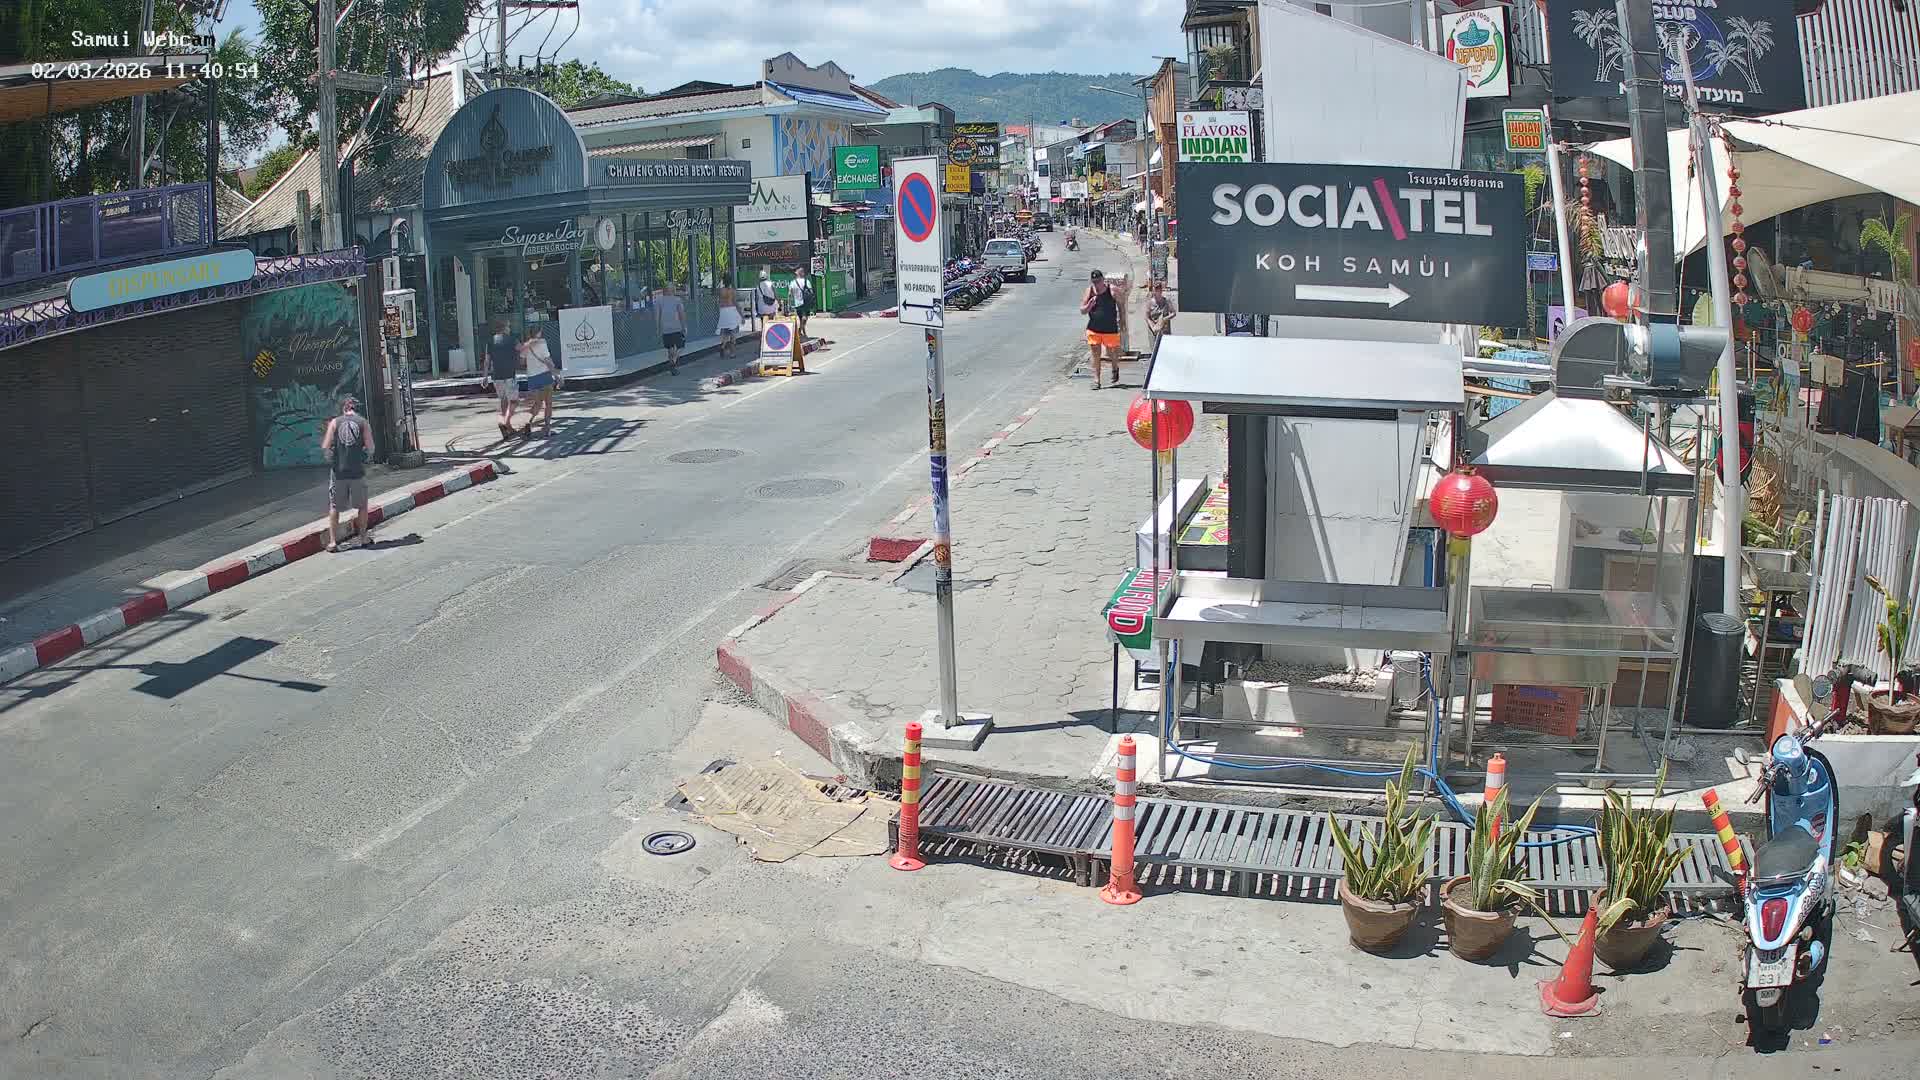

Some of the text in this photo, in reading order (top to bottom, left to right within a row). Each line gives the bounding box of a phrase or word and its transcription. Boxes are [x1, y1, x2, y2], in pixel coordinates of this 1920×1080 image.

[1477, 11, 1490, 22] FOOD
[1653, 5, 1697, 21] CLUB
[1183, 125, 1247, 137] FLAVORS
[1508, 121, 1541, 133] INDIAN
[1181, 137, 1248, 155] INDIAN
[1511, 134, 1541, 147] FOOD
[609, 164, 745, 177] CHAWENG GARDEN BEACH RESORT
[837, 174, 878, 184] EXCHANGE
[1255, 254, 1449, 278] KOH SAMUI
[904, 283, 936, 293] NO PARKING
